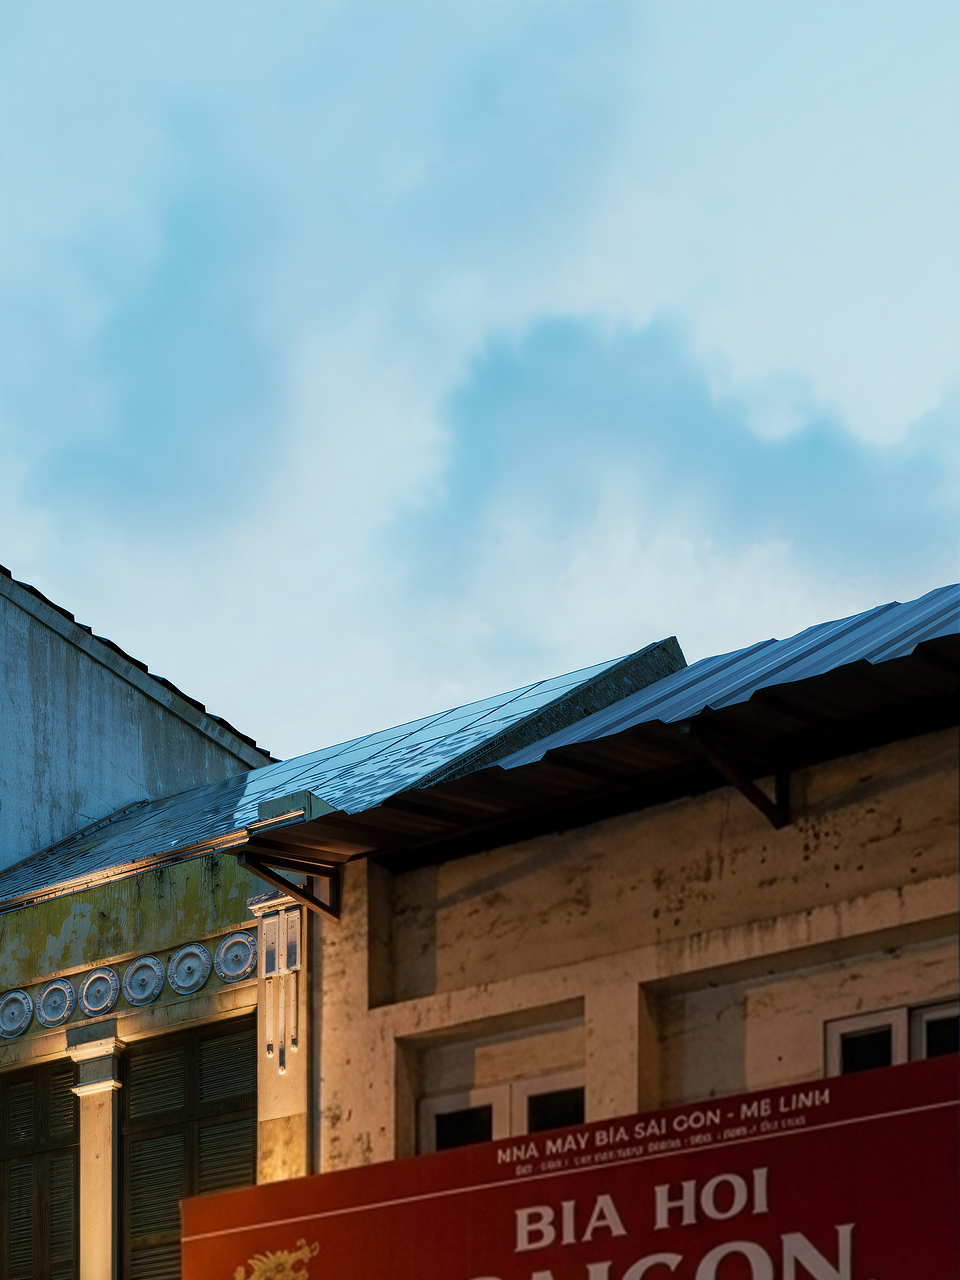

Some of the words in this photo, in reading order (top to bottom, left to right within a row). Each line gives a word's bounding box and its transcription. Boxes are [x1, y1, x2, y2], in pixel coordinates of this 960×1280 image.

[545, 1132, 589, 1155] MAY
[595, 1126, 629, 1147] BIA
[633, 1118, 667, 1140] SAI
[514, 1193, 628, 1253] BIA
[653, 1166, 770, 1231] HOI
